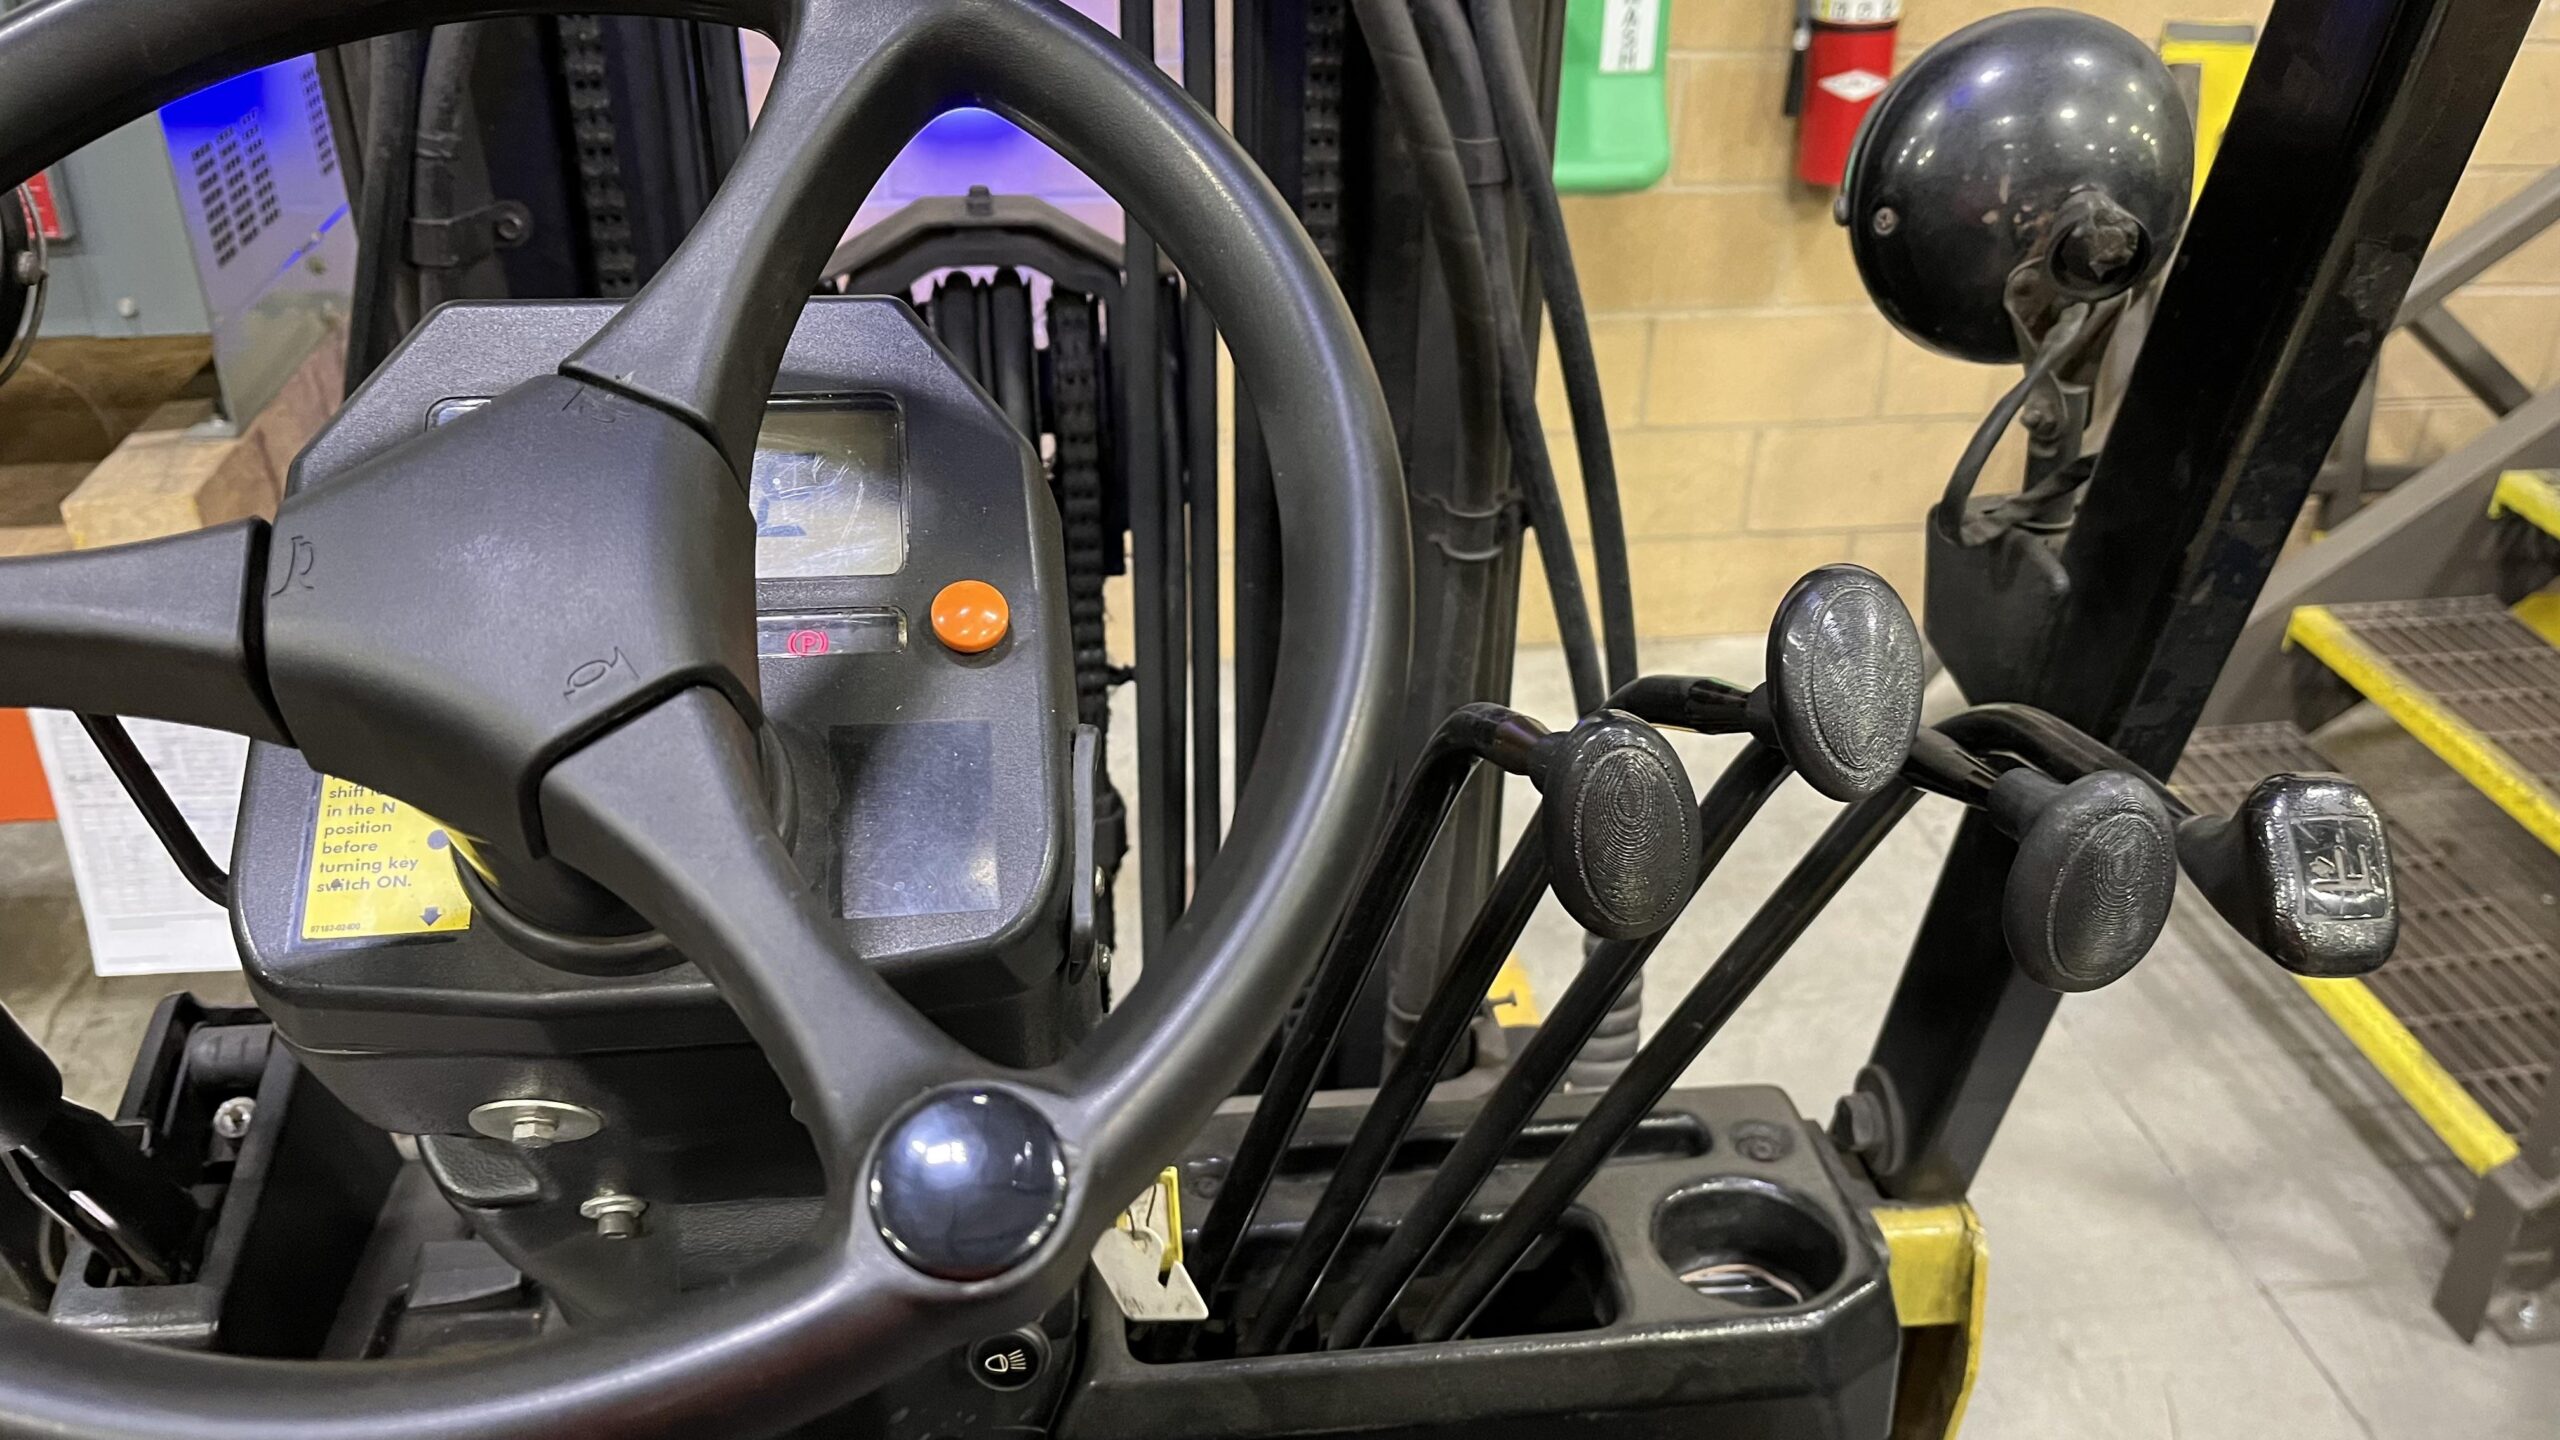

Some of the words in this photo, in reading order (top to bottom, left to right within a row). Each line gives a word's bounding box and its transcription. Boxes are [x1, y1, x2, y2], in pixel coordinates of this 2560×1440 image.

[1618, 0, 1640, 70] ASH
[329, 785, 365, 799] shift
[326, 804, 342, 817] in
[349, 803, 375, 816] the
[381, 802, 396, 815] N
[324, 821, 392, 839] position
[322, 841, 378, 854] before
[319, 857, 382, 873] turning
[388, 856, 419, 871] key
[316, 877, 370, 892] switch
[376, 874, 412, 889] ON.
